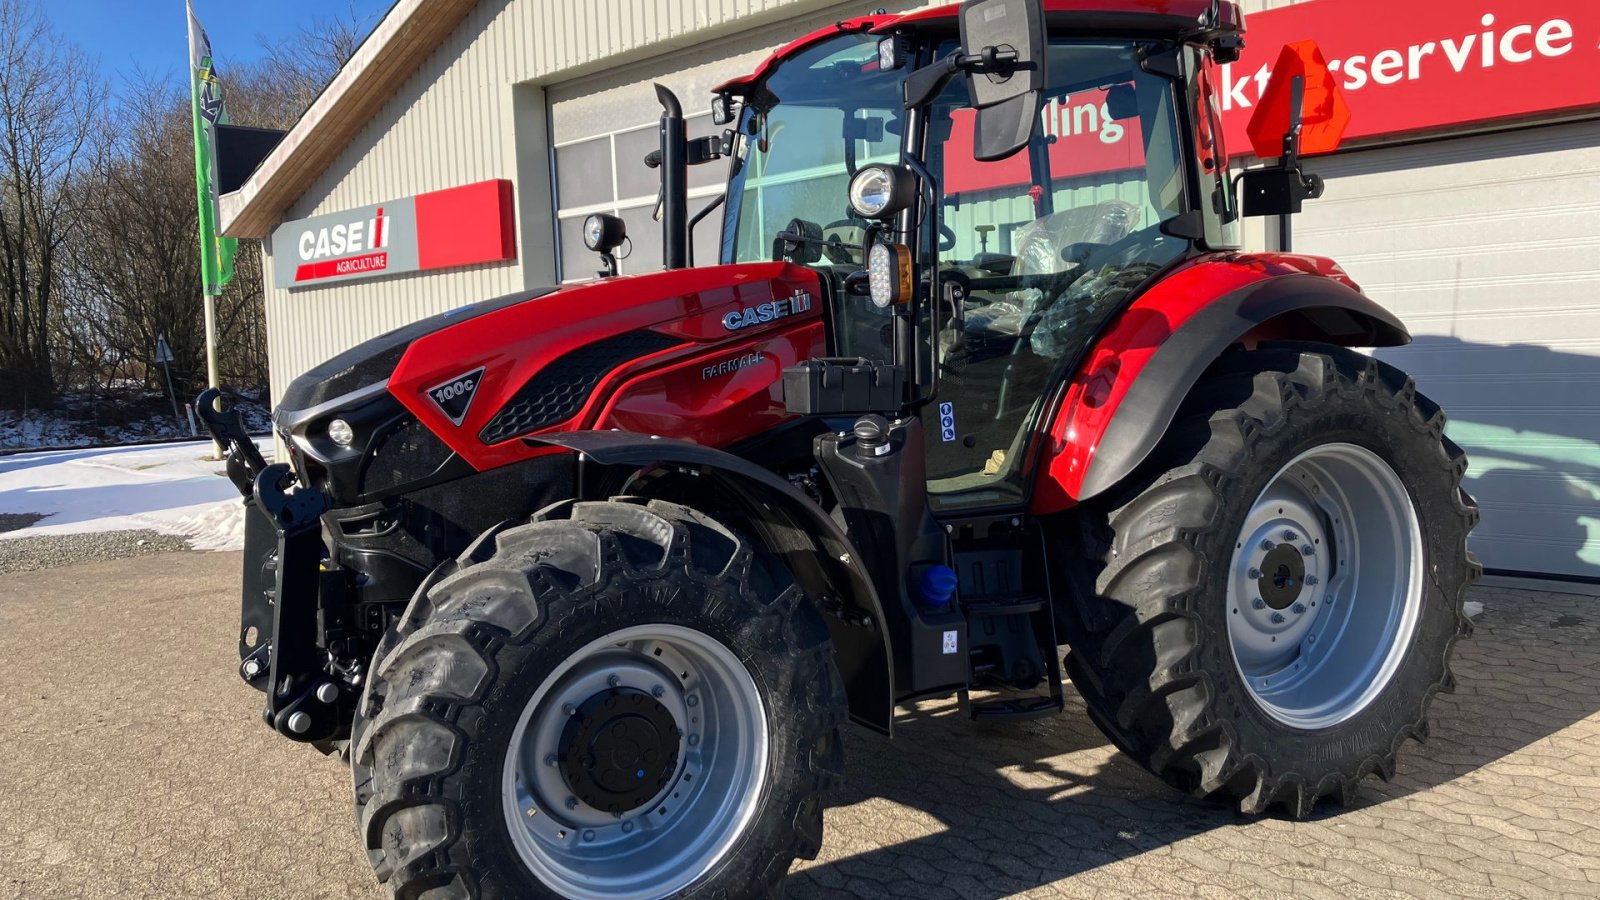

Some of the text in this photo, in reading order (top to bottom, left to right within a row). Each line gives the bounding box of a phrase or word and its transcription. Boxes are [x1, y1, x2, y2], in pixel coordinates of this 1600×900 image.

[1041, 13, 1573, 144] lling ktservice
[298, 221, 364, 261] CASE
[336, 255, 385, 273] AGRICULTURE
[722, 299, 789, 331] CASE
[703, 351, 764, 380] FARMALL
